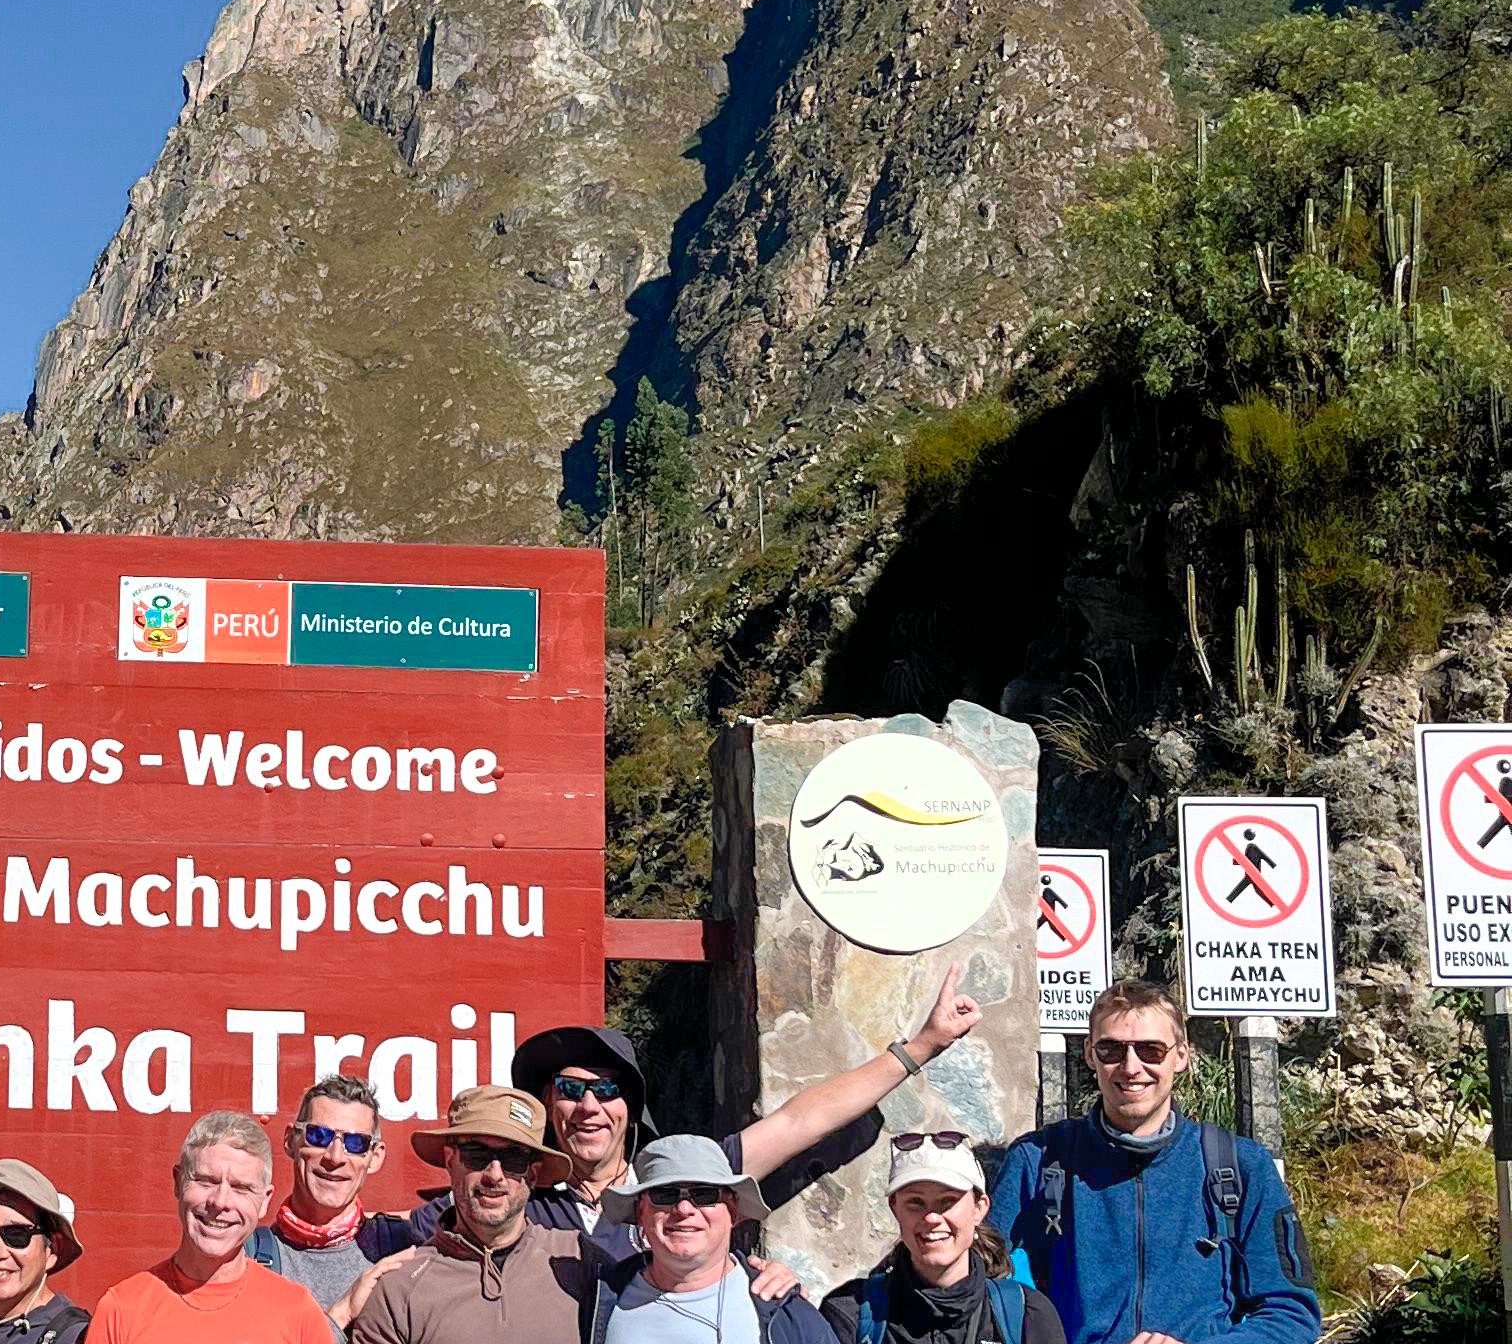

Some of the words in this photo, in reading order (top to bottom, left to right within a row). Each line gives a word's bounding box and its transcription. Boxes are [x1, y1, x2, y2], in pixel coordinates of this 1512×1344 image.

[213, 607, 280, 638] PERÚ
[301, 613, 402, 634] Ministerio
[408, 616, 433, 635] de
[439, 617, 511, 638] Cultura
[139, 754, 163, 766] -
[179, 730, 499, 794] Welcome
[924, 799, 991, 813] SERNANP
[895, 859, 995, 875] Machupicchu
[4, 855, 545, 950] Machupicchu
[1443, 923, 1481, 943] USO
[1195, 941, 1263, 959] CHAKA
[1268, 942, 1319, 960] TREN
[1445, 951, 1509, 967] PERSONAL
[1230, 966, 1286, 982] AMA
[1197, 986, 1321, 1003] CHIMPAYCHU
[227, 1004, 517, 1121] Trail
